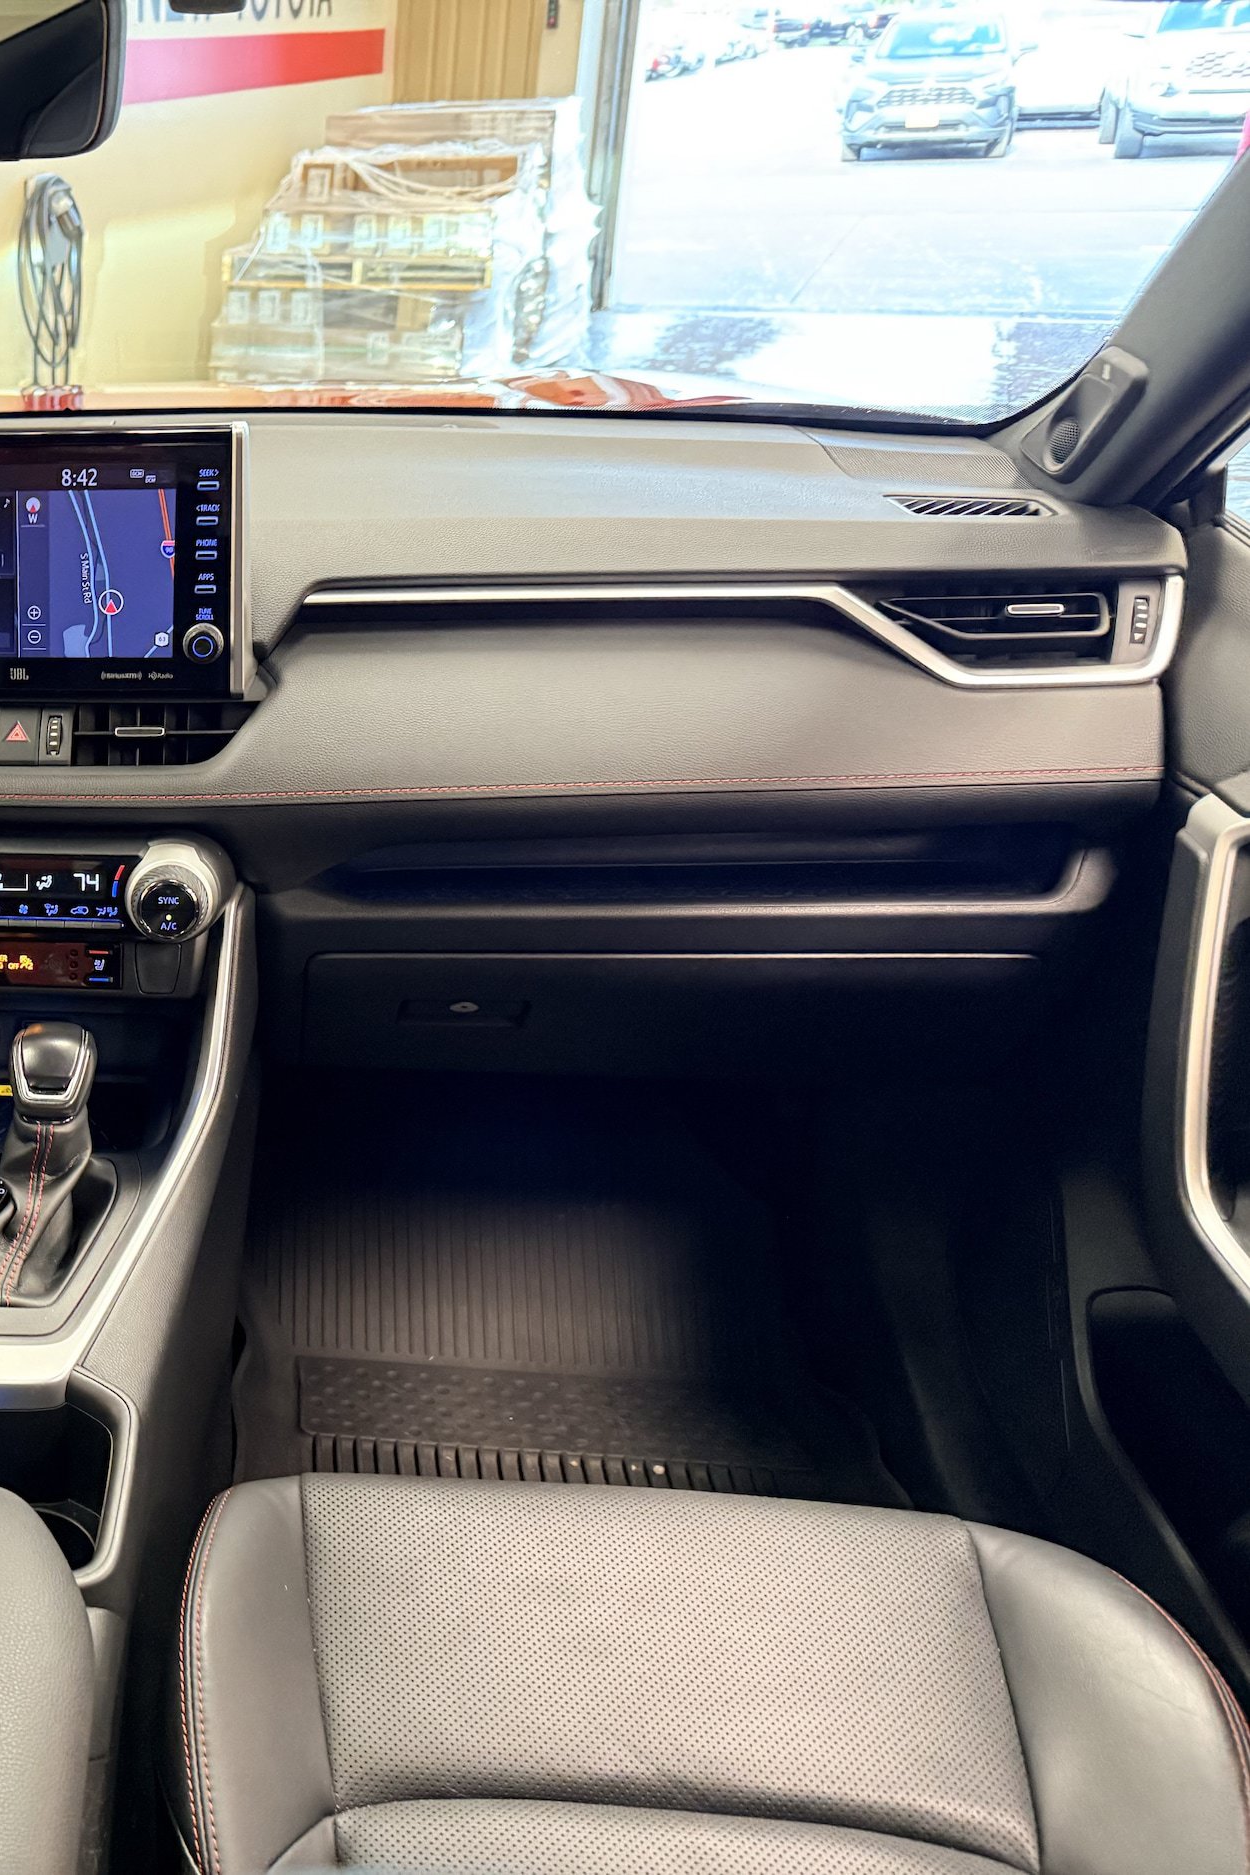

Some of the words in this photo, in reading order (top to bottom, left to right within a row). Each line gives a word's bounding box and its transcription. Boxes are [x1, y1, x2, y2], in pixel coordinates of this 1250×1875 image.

[61, 468, 98, 486] 8:42
[28, 514, 37, 523] W
[196, 539, 218, 547] PHONE
[79, 552, 88, 560] S
[80, 560, 91, 581] Main
[198, 573, 214, 581] APPS
[10, 668, 29, 680] JBL
[73, 873, 100, 891] 74
[158, 896, 179, 905] SYNC
[160, 922, 177, 931] A/C
